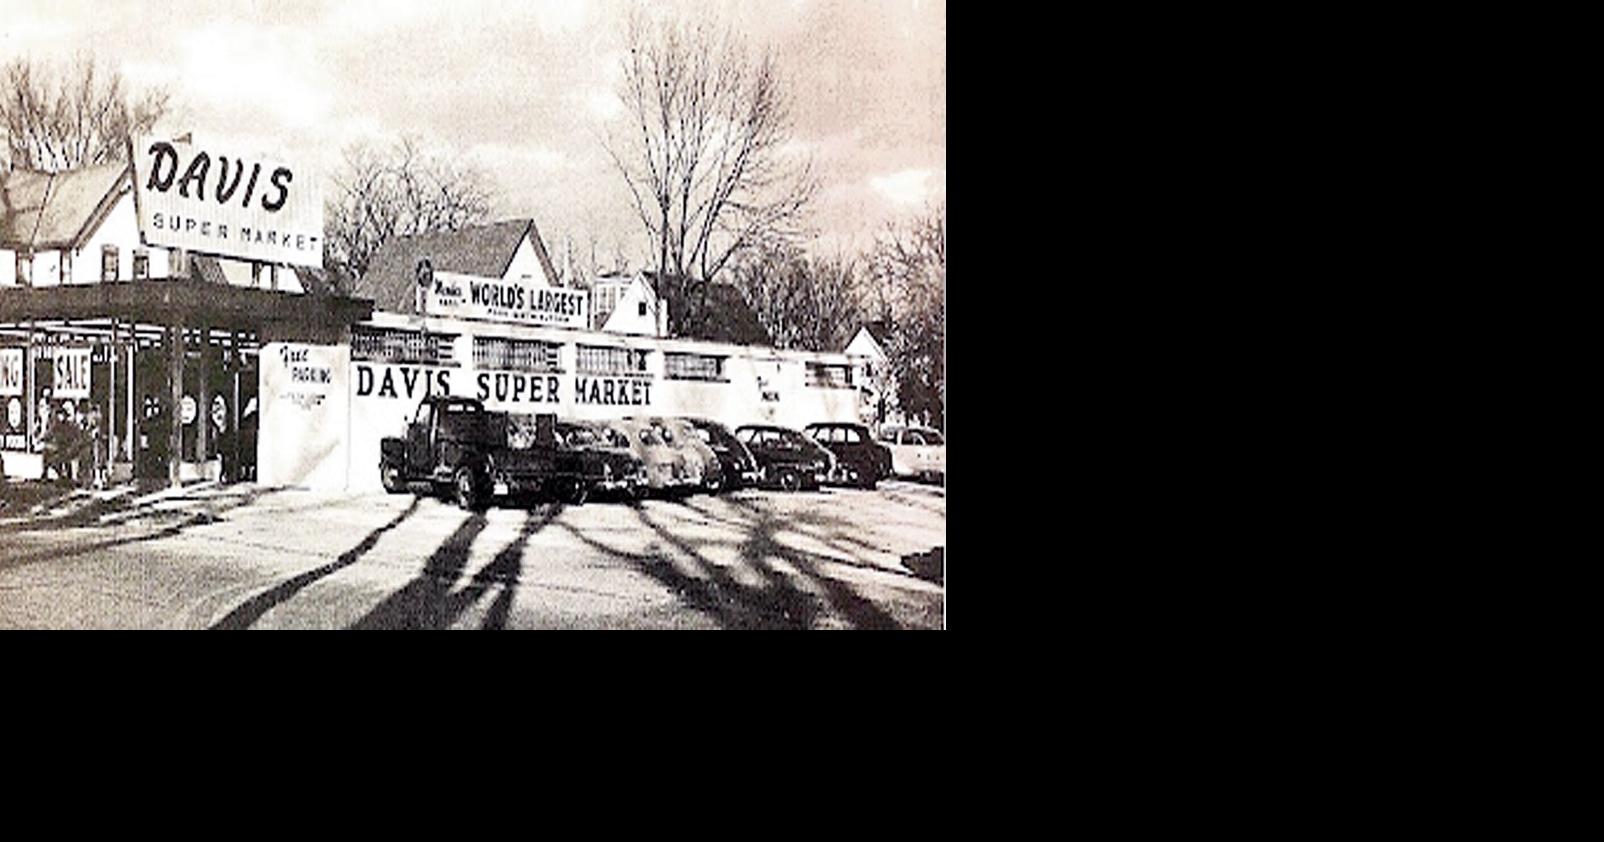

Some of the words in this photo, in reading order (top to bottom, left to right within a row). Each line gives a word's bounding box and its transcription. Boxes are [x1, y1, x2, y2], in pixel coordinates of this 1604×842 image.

[146, 141, 293, 213] DAVIS
[153, 213, 229, 239] SUPER
[240, 227, 318, 251] MARKET
[470, 281, 524, 310] WORLD'S
[530, 289, 583, 316] LARGEST
[57, 355, 88, 390] SALE
[356, 365, 450, 399] DAVIS
[477, 373, 560, 403] SUPER
[575, 377, 651, 405] MARKET
